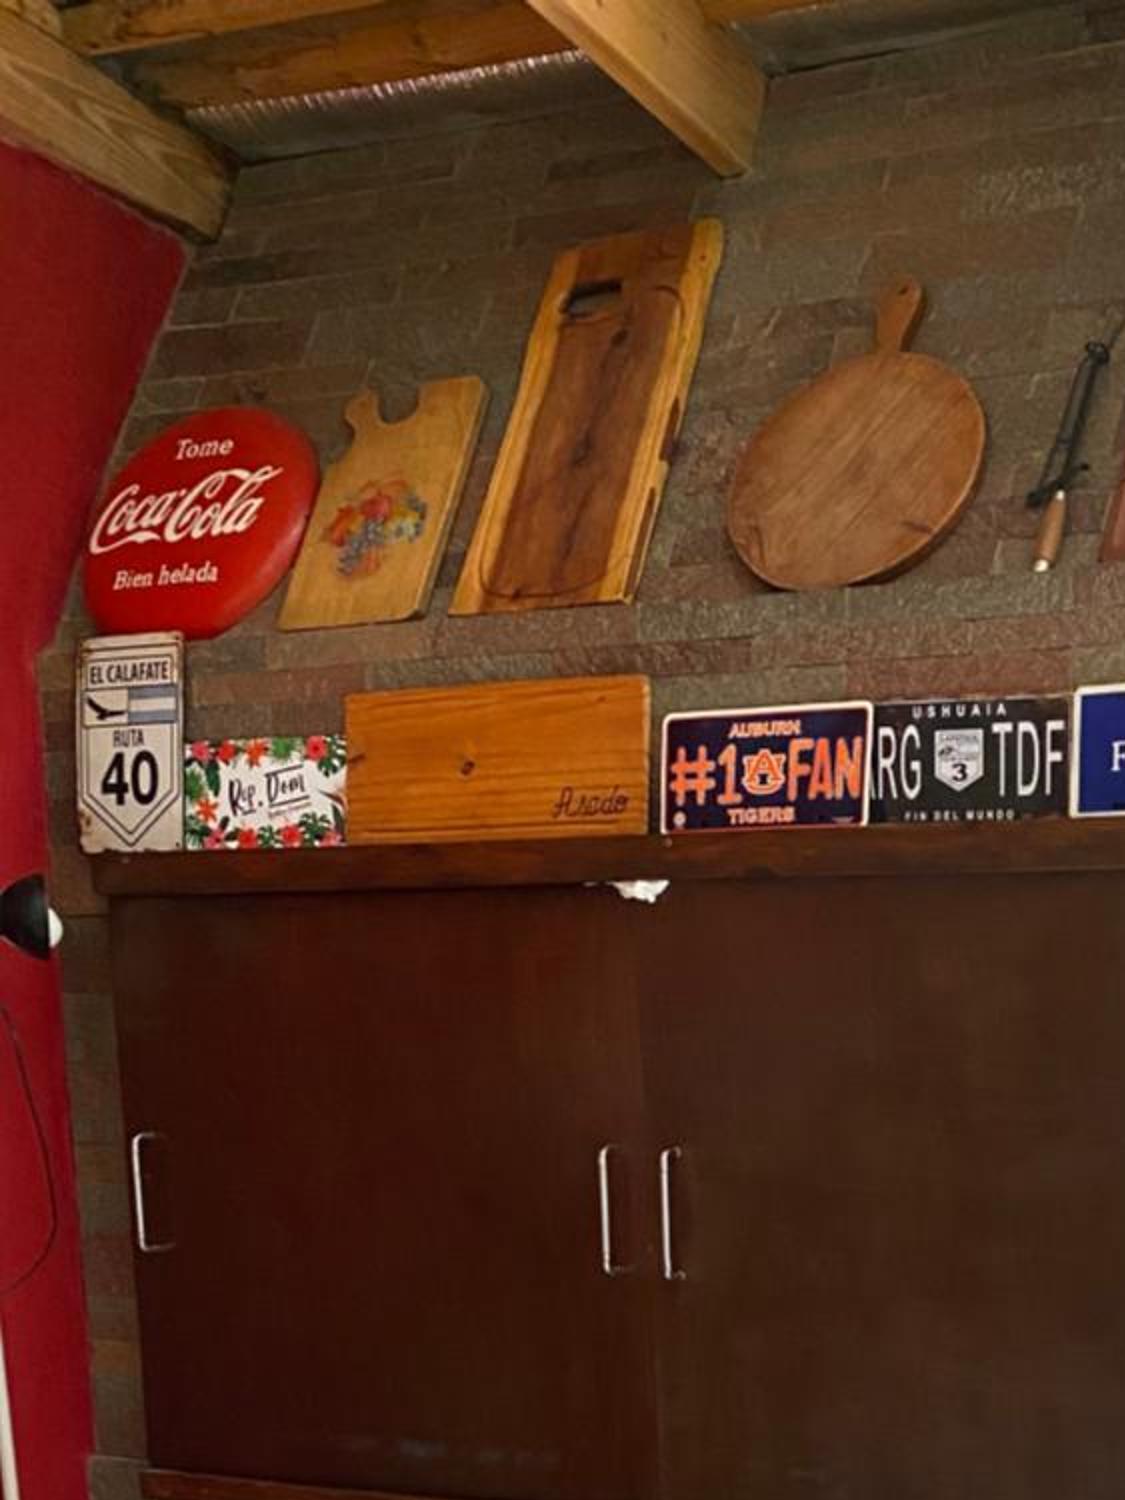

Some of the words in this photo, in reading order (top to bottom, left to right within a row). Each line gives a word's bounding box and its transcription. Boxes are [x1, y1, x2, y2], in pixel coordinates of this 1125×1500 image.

[176, 437, 235, 461] Tome
[112, 569, 153, 591] Bien
[157, 560, 219, 588] helada
[89, 666, 105, 685] EL
[106, 661, 169, 683] CALAFATE
[912, 703, 1008, 719] USHUAIA
[113, 729, 145, 748] RUTA
[728, 718, 802, 739] AUBURN
[669, 744, 743, 807] #1
[787, 735, 863, 802] FAN
[870, 724, 923, 801] RG
[991, 719, 1065, 797] TDF
[101, 750, 159, 806] 40
[952, 763, 968, 782] 3
[727, 806, 796, 825] TIGERS
[904, 810, 928, 822] FIN
[933, 809, 959, 821] DEL
[965, 808, 1016, 822] MUNDO
